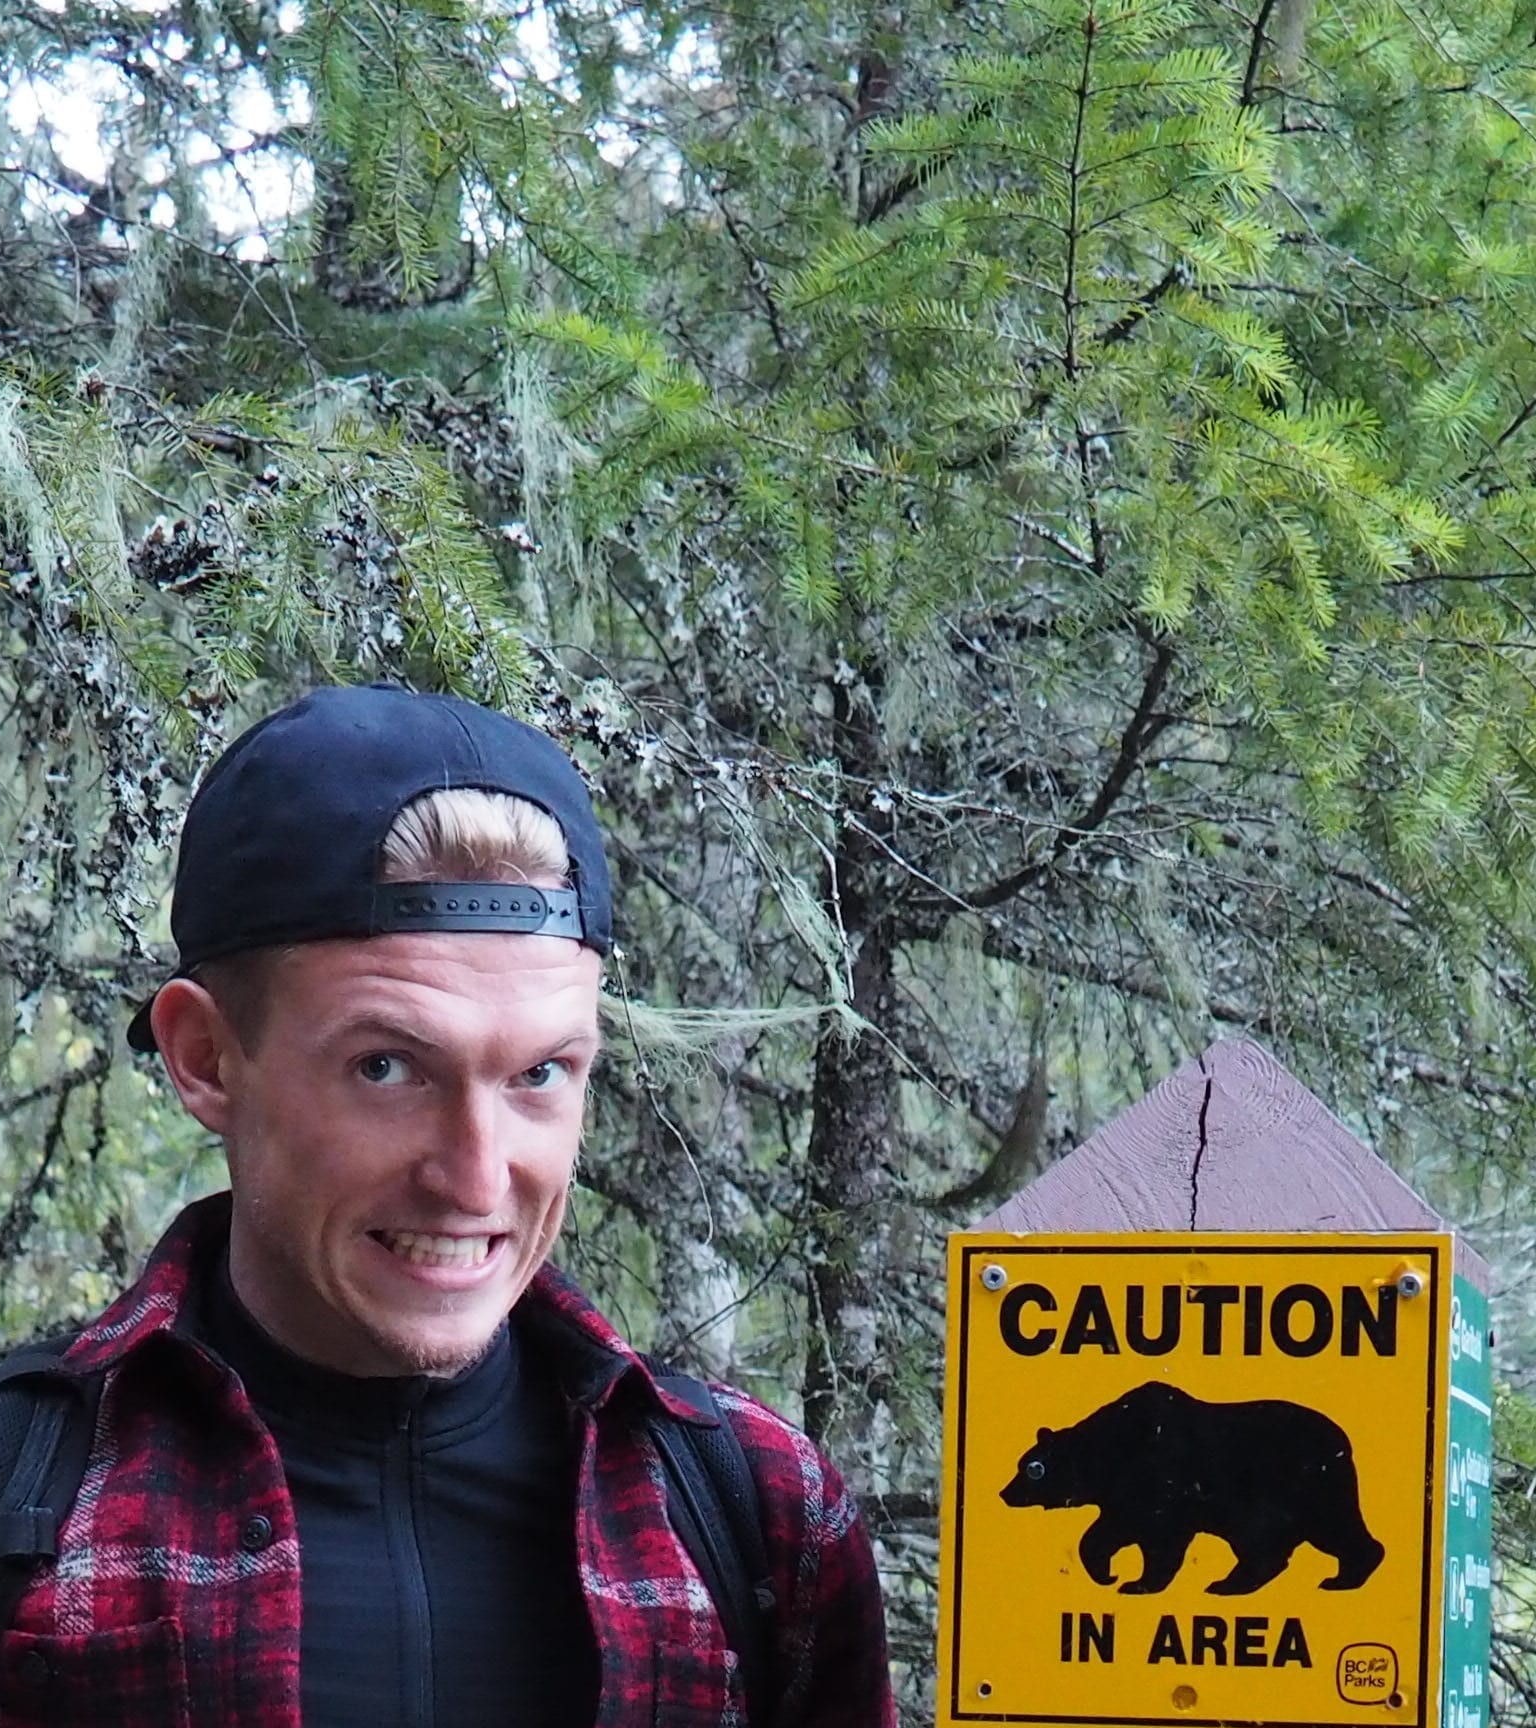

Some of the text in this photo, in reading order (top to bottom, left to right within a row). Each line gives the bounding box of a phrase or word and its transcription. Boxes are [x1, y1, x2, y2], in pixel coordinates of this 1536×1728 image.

[998, 1283, 1398, 1358] CAUTION
[1060, 1612, 1314, 1669] IN AREA
[1344, 1673, 1386, 1688] Parks
[1345, 1659, 1367, 1674] BC
